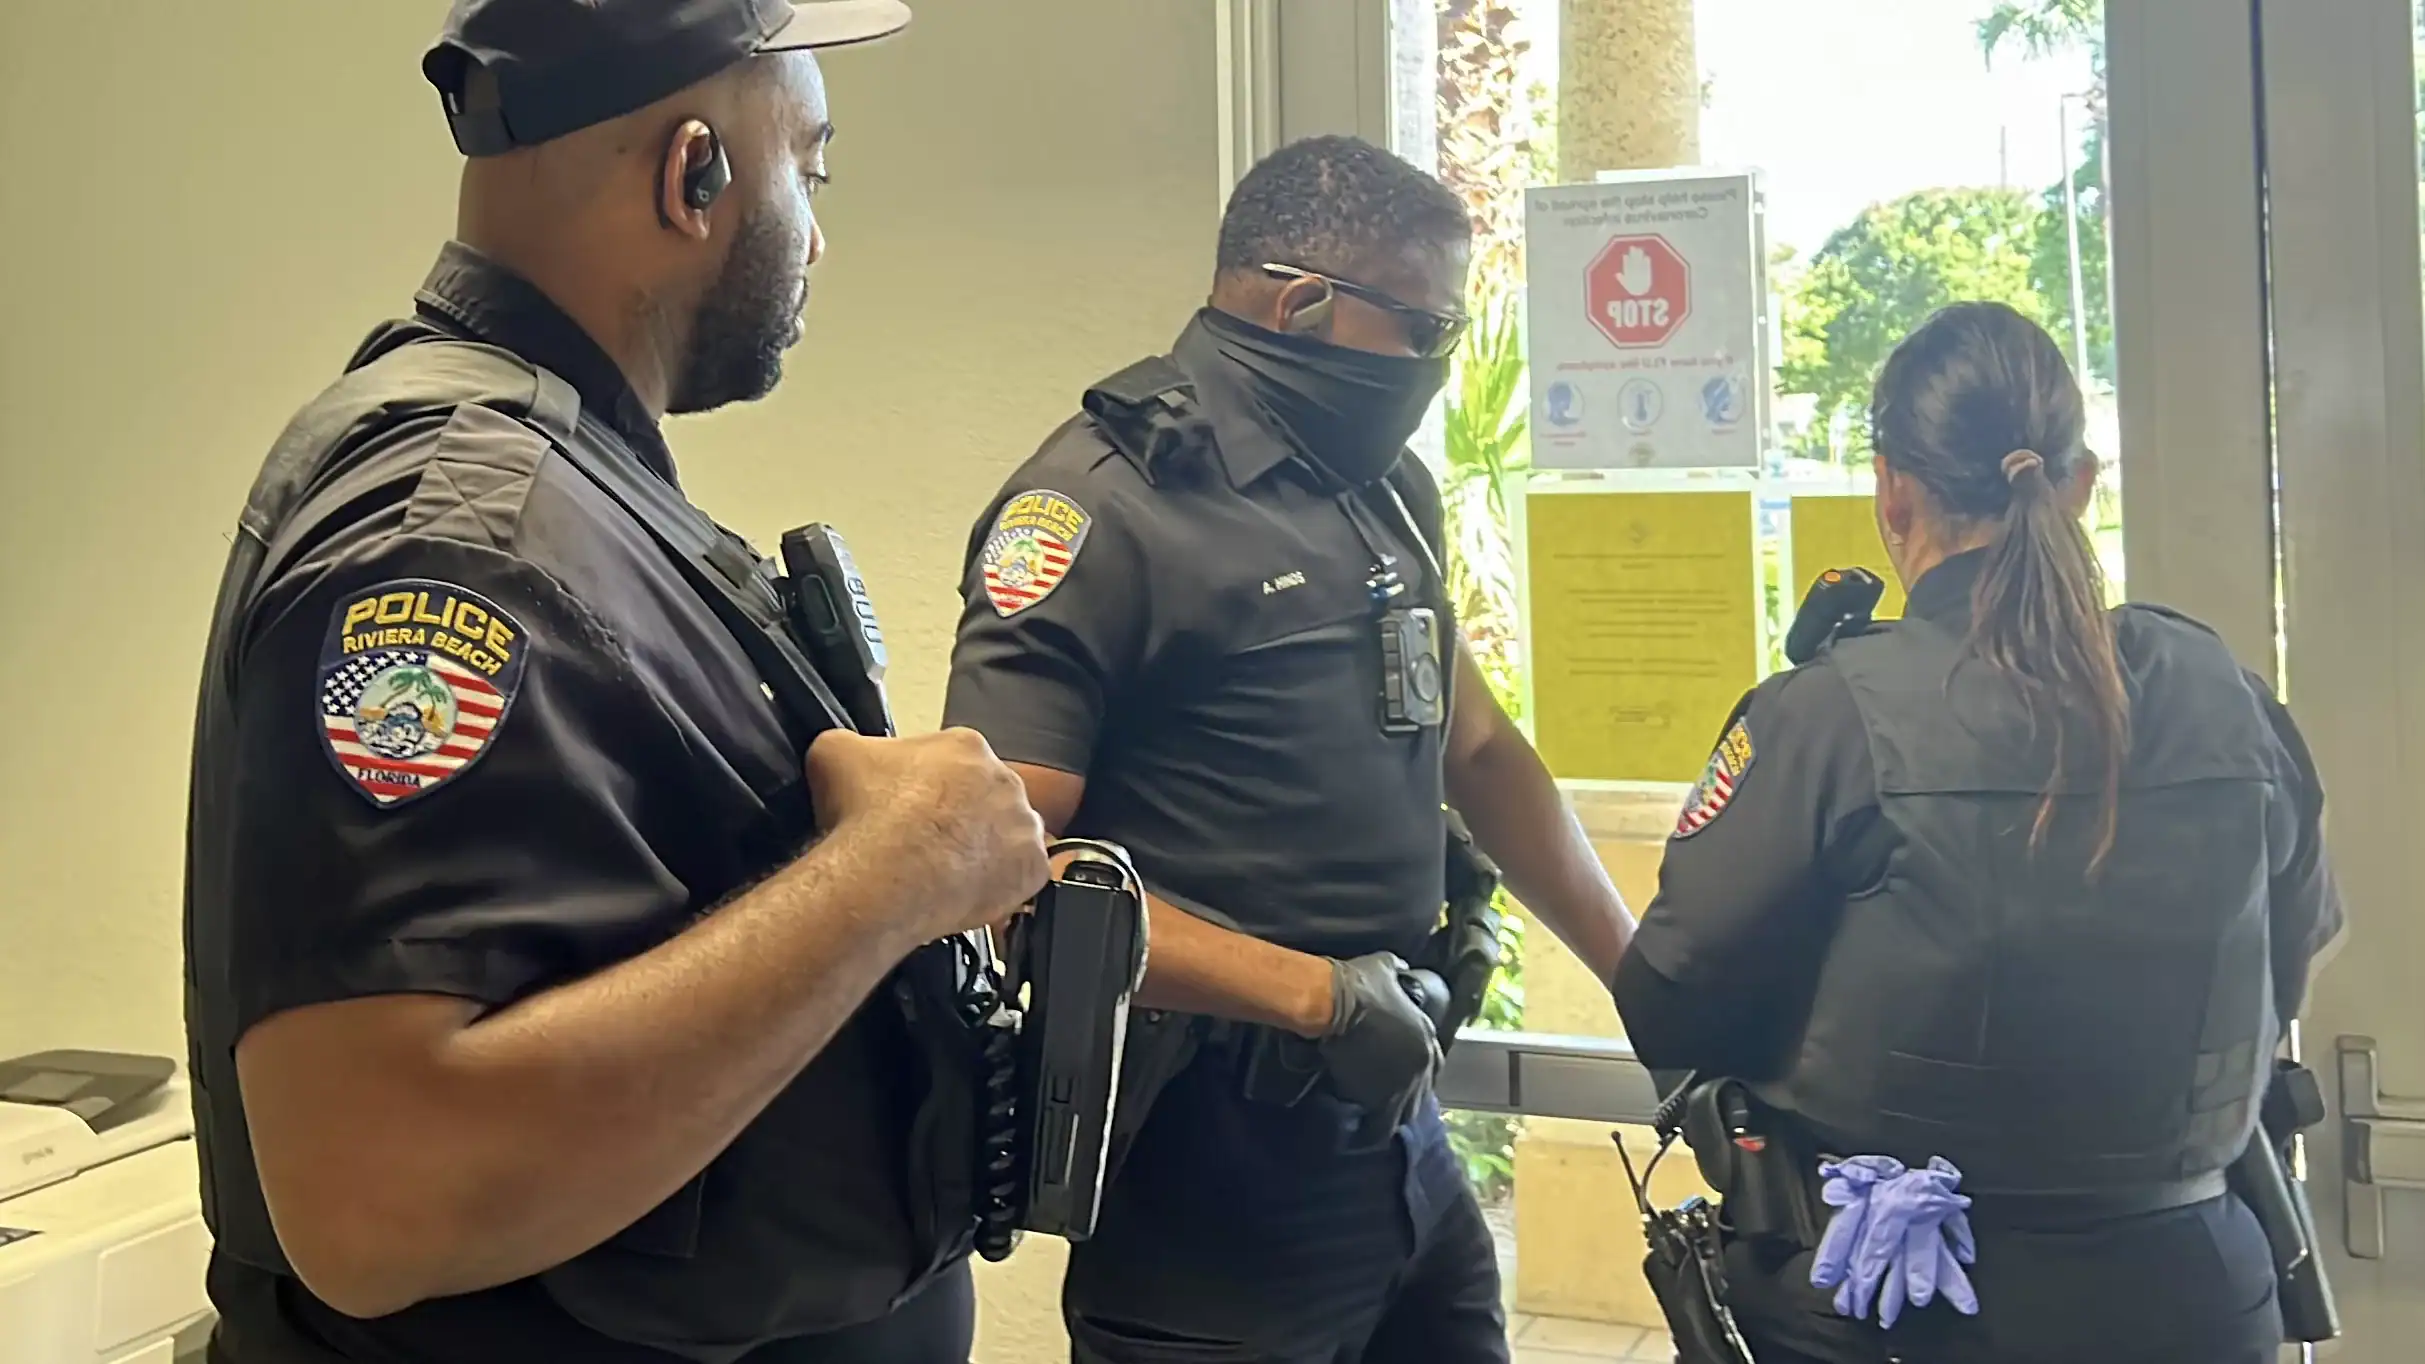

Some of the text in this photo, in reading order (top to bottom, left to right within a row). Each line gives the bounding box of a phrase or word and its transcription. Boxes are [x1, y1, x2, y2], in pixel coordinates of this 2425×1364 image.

[1002, 494, 1084, 534] POLICE
[341, 591, 515, 662] POLICE
[342, 627, 503, 676] RIVIERA BEACH
[356, 767, 422, 788] FLORIDA
